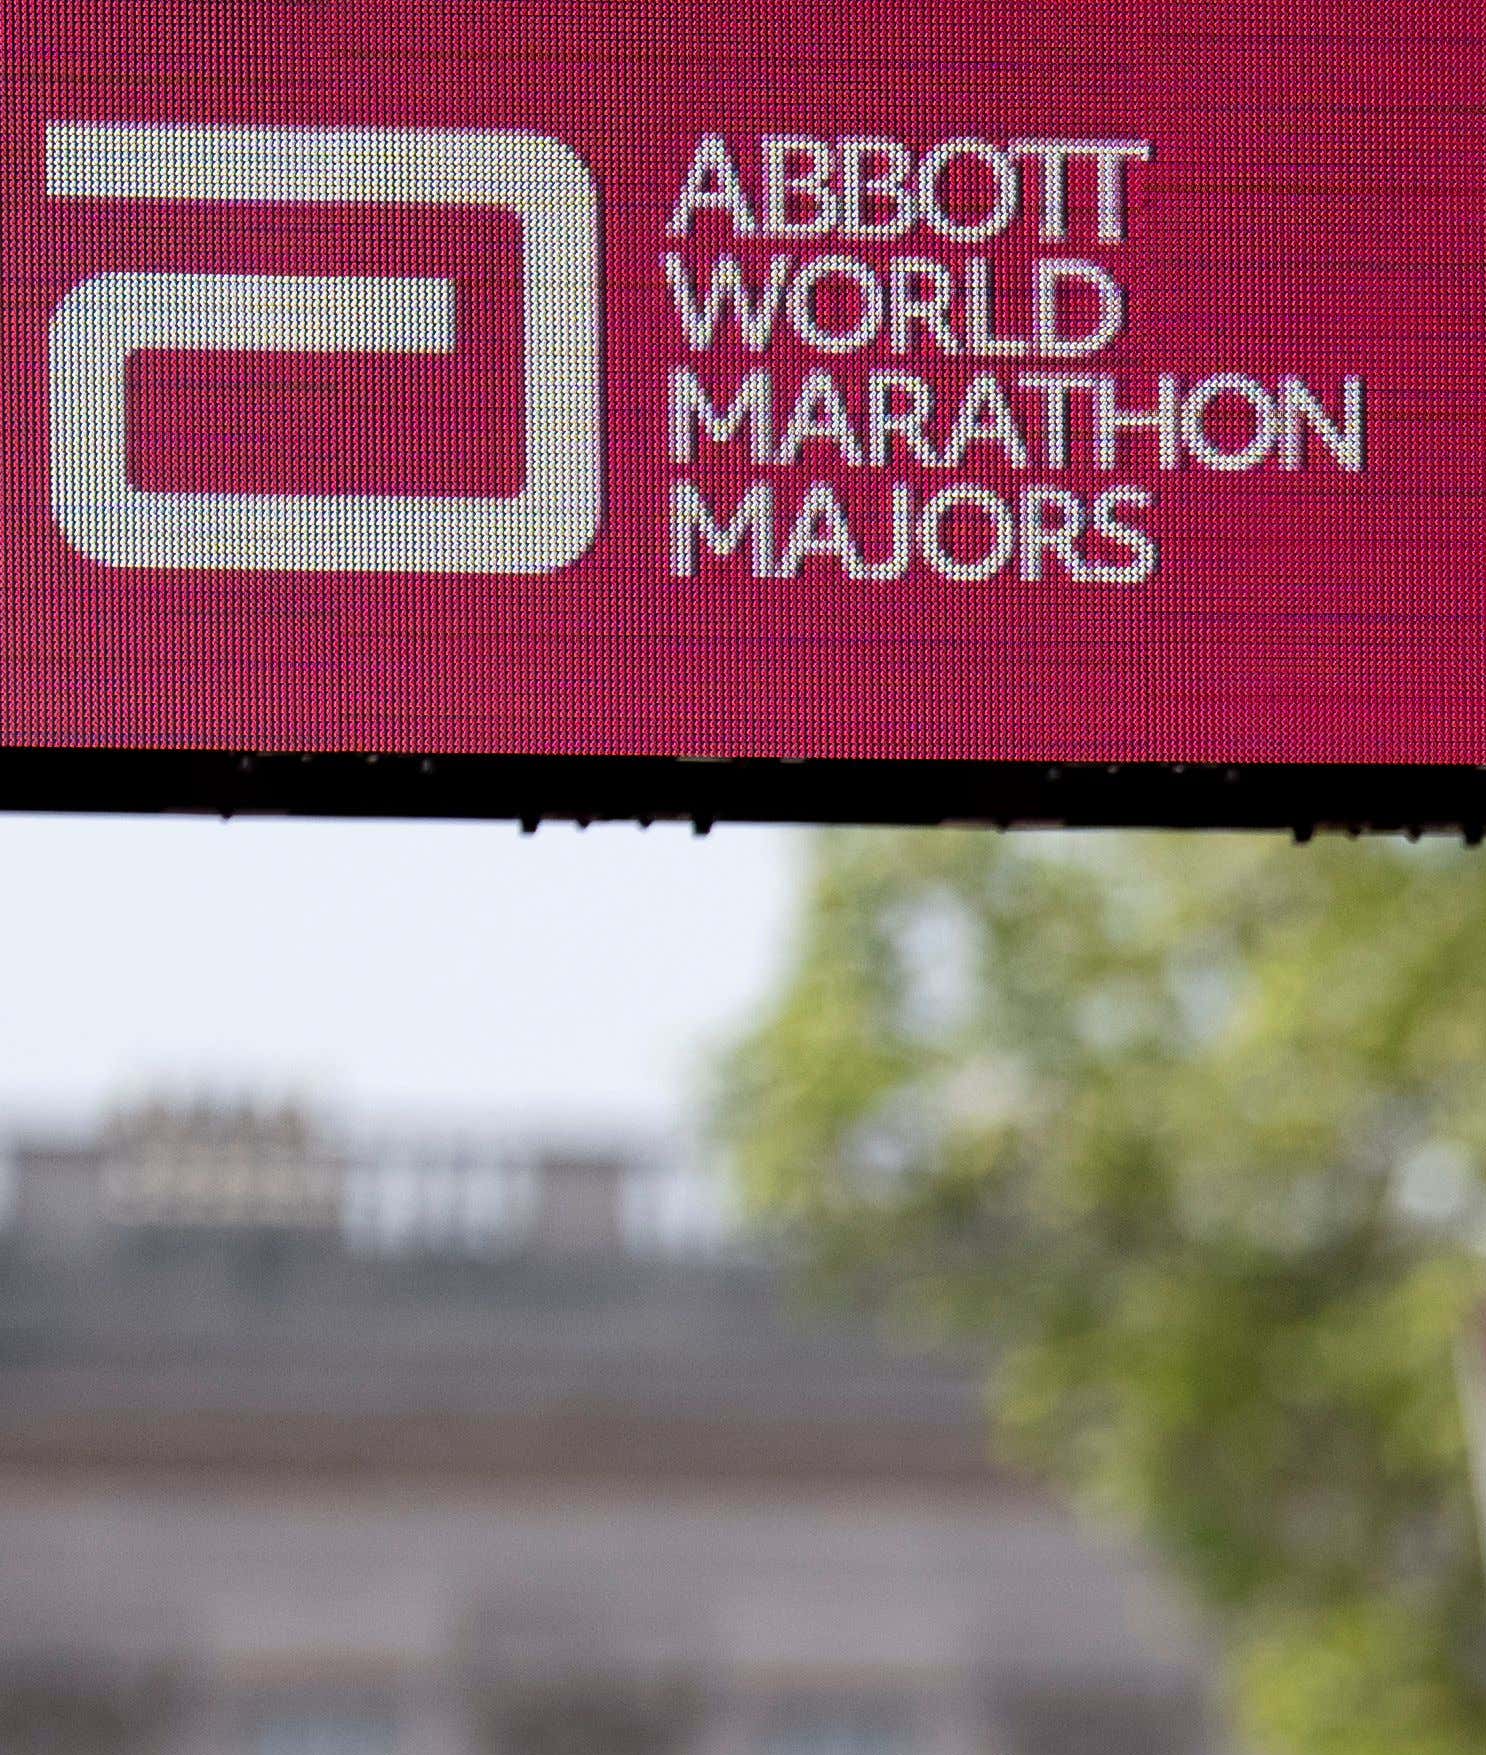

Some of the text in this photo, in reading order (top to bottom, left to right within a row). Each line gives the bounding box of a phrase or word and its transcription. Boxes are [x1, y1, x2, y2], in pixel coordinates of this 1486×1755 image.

[667, 134, 1154, 240] ABBOTT
[664, 252, 1124, 357] WORLD
[667, 366, 1364, 472] MARATHON
[669, 480, 1159, 583] MAJORS
